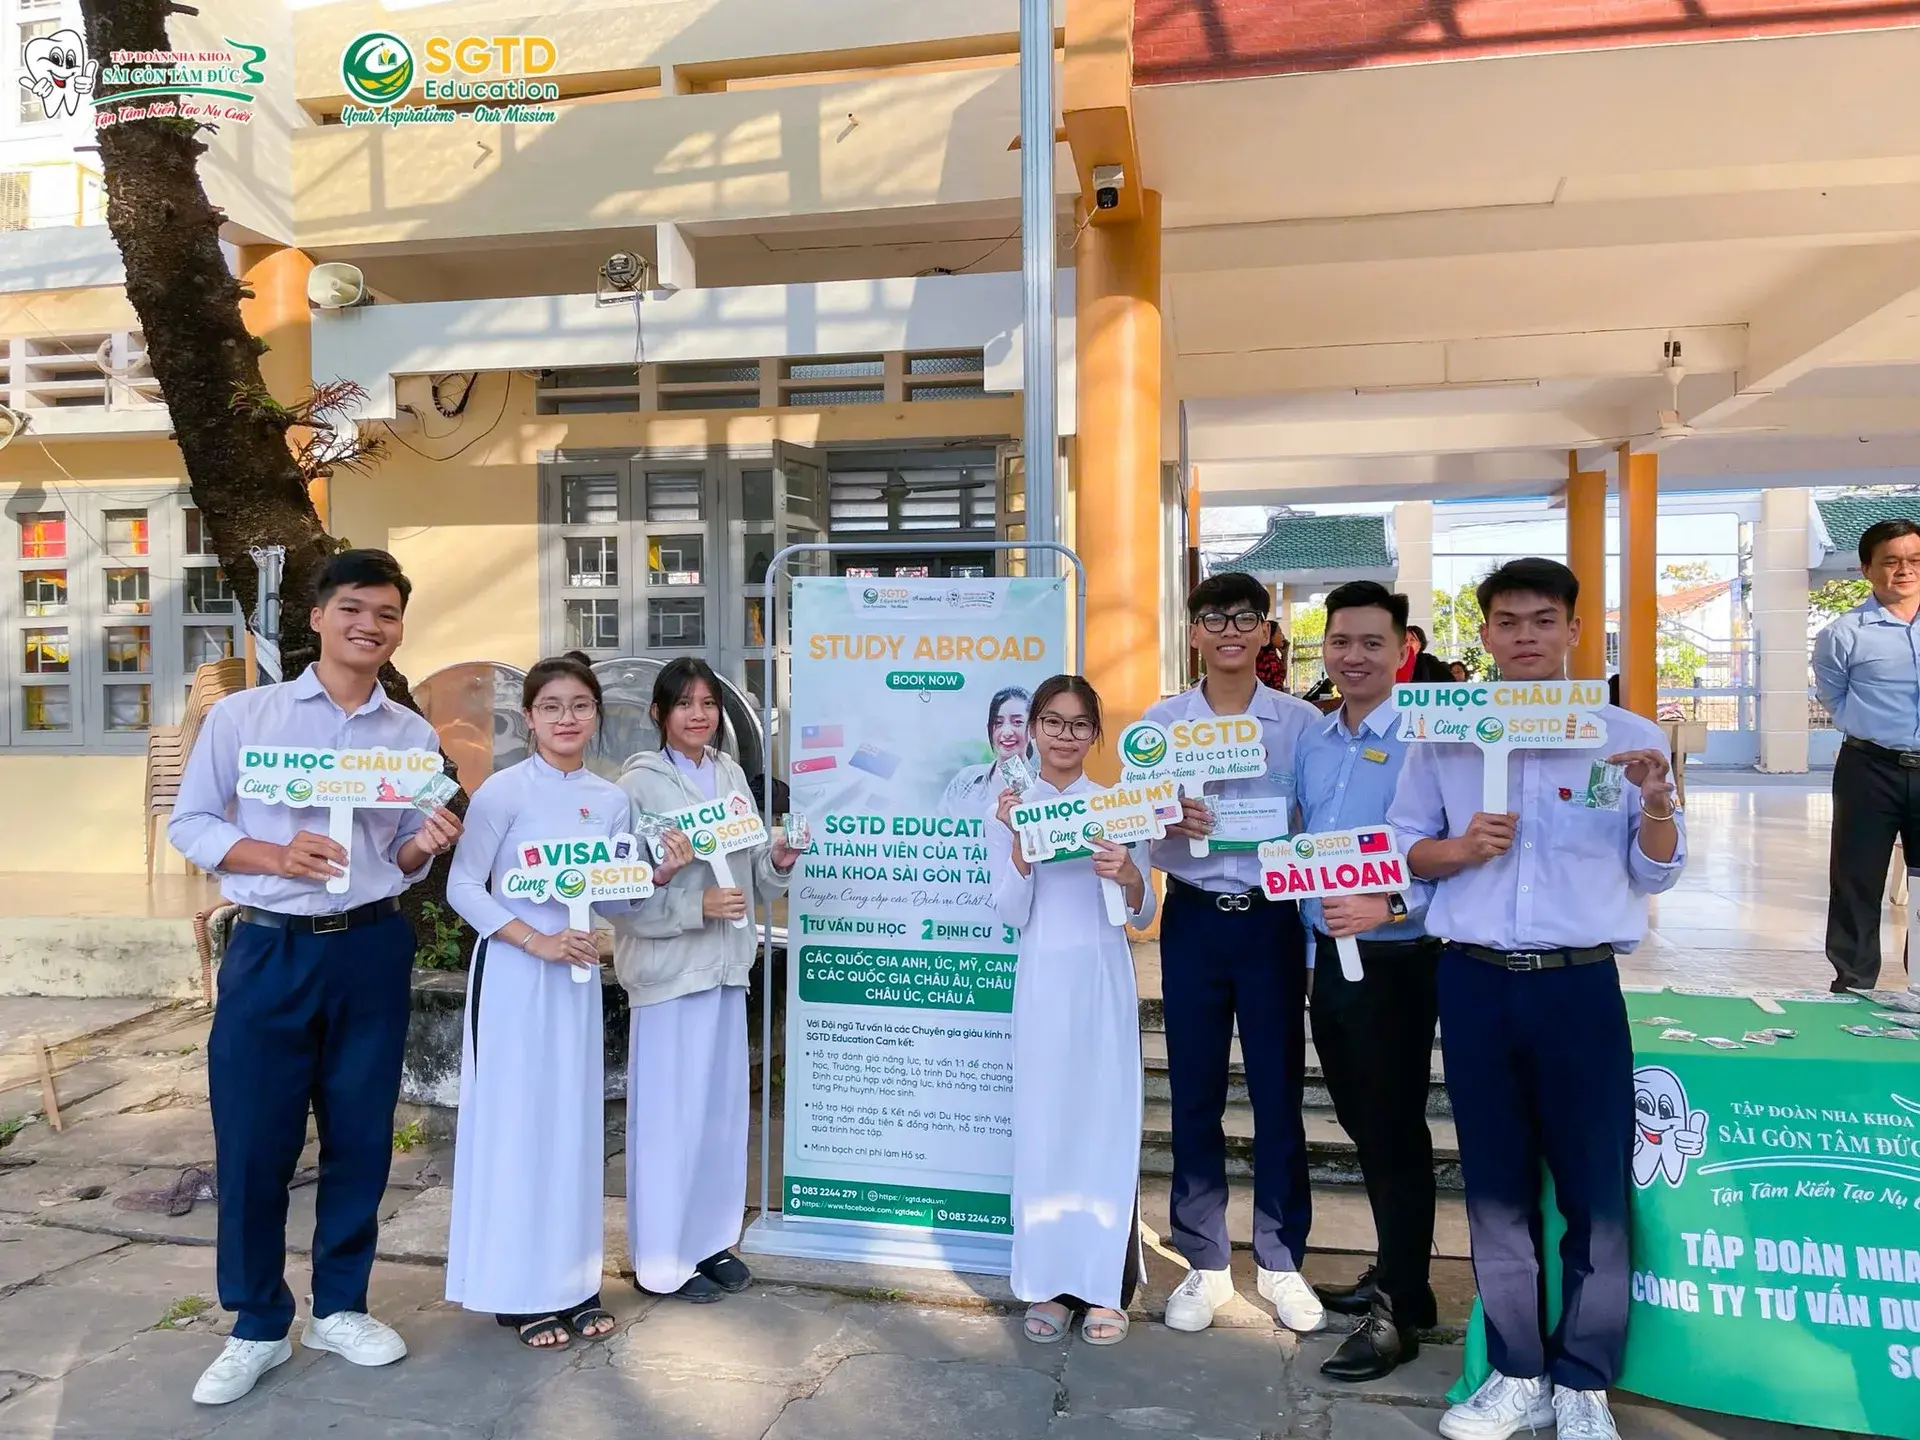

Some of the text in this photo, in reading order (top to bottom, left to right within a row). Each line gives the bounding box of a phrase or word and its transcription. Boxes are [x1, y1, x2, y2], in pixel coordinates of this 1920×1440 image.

[809, 634, 1046, 661] STUDY ABROAD
[892, 675, 957, 686] BOOK NOW
[1398, 683, 1601, 711] DU HỌC CHÂU ÂU
[1173, 720, 1257, 748] SGTD
[1434, 719, 1470, 740] Cùng
[1508, 719, 1561, 733] SGTD
[1508, 735, 1563, 743] Education
[246, 752, 438, 773] DU HỌC CHÂU ÚC
[1175, 747, 1260, 763] Education
[1127, 771, 1146, 783] Your
[1208, 763, 1225, 775] Our
[1227, 761, 1260, 774] Mission
[243, 778, 281, 798] Cùng
[317, 781, 366, 794] SGTD
[316, 794, 367, 802] Education
[1016, 780, 1174, 825] DU HỌC CHÂU MỸ
[699, 802, 726, 824] CƯ
[1106, 814, 1147, 831] SGTD
[716, 818, 760, 840] SGTD
[825, 815, 885, 834] SGTD
[1108, 828, 1150, 840] Education
[722, 832, 765, 849] Education
[1050, 829, 1078, 845] Cùng
[1316, 836, 1352, 849] SGTD
[543, 842, 611, 866] VISA
[824, 840, 876, 857] THÀNH
[882, 841, 917, 858] VIÊN
[923, 842, 957, 859] CỦA
[1318, 849, 1354, 858] Education
[590, 866, 648, 886] SGTD
[805, 864, 960, 883] NHA KHOA SÀI GÒN
[1266, 860, 1402, 894] ĐÀI LOAN
[508, 874, 548, 897] Cùng
[591, 885, 649, 896] Education
[799, 914, 906, 937] 1 TƯ VẤN DU HỌC
[922, 919, 992, 939] 2 ĐỊNH CƯ
[1002, 923, 1014, 943] 3
[805, 950, 832, 963] CÁC
[835, 951, 873, 965] QUỐC
[876, 956, 898, 967] GIA
[901, 957, 931, 970] ANH,
[935, 956, 955, 971] ÚC,
[959, 957, 981, 973] MỸ,
[806, 967, 1011, 989] & CÁC QUỐC GIA CHÂU ÂU, CHÂU
[865, 987, 975, 1004] CHÂU ÚC, CHÂU Á
[806, 1032, 830, 1041] SGTD
[832, 1034, 874, 1044] Education
[876, 1037, 896, 1046] Cam
[947, 1028, 961, 1038] gia
[985, 1030, 1002, 1039] kinh
[940, 1112, 951, 1120] Du
[1731, 1101, 1915, 1128] TẬP ĐOÀN NHA KHOA
[1718, 1121, 1756, 1145] SÀI
[1762, 1125, 1813, 1149] GÒN
[1818, 1129, 1872, 1154] TÂM
[802, 1186, 857, 1198] 083 2244 279
[1711, 1187, 1743, 1207] Tận
[1750, 1182, 1788, 1199] Tâm
[1795, 1180, 1836, 1199] Kiến
[1844, 1182, 1875, 1203] Tạo
[1880, 1188, 1908, 1209] Nụ
[949, 1212, 1007, 1225] 083 2244 279
[1681, 1229, 1744, 1274] TẬP
[1755, 1236, 1846, 1277] ĐOÀN
[1632, 1270, 1920, 1332] CÔNG TY TƯ VẤN DU
